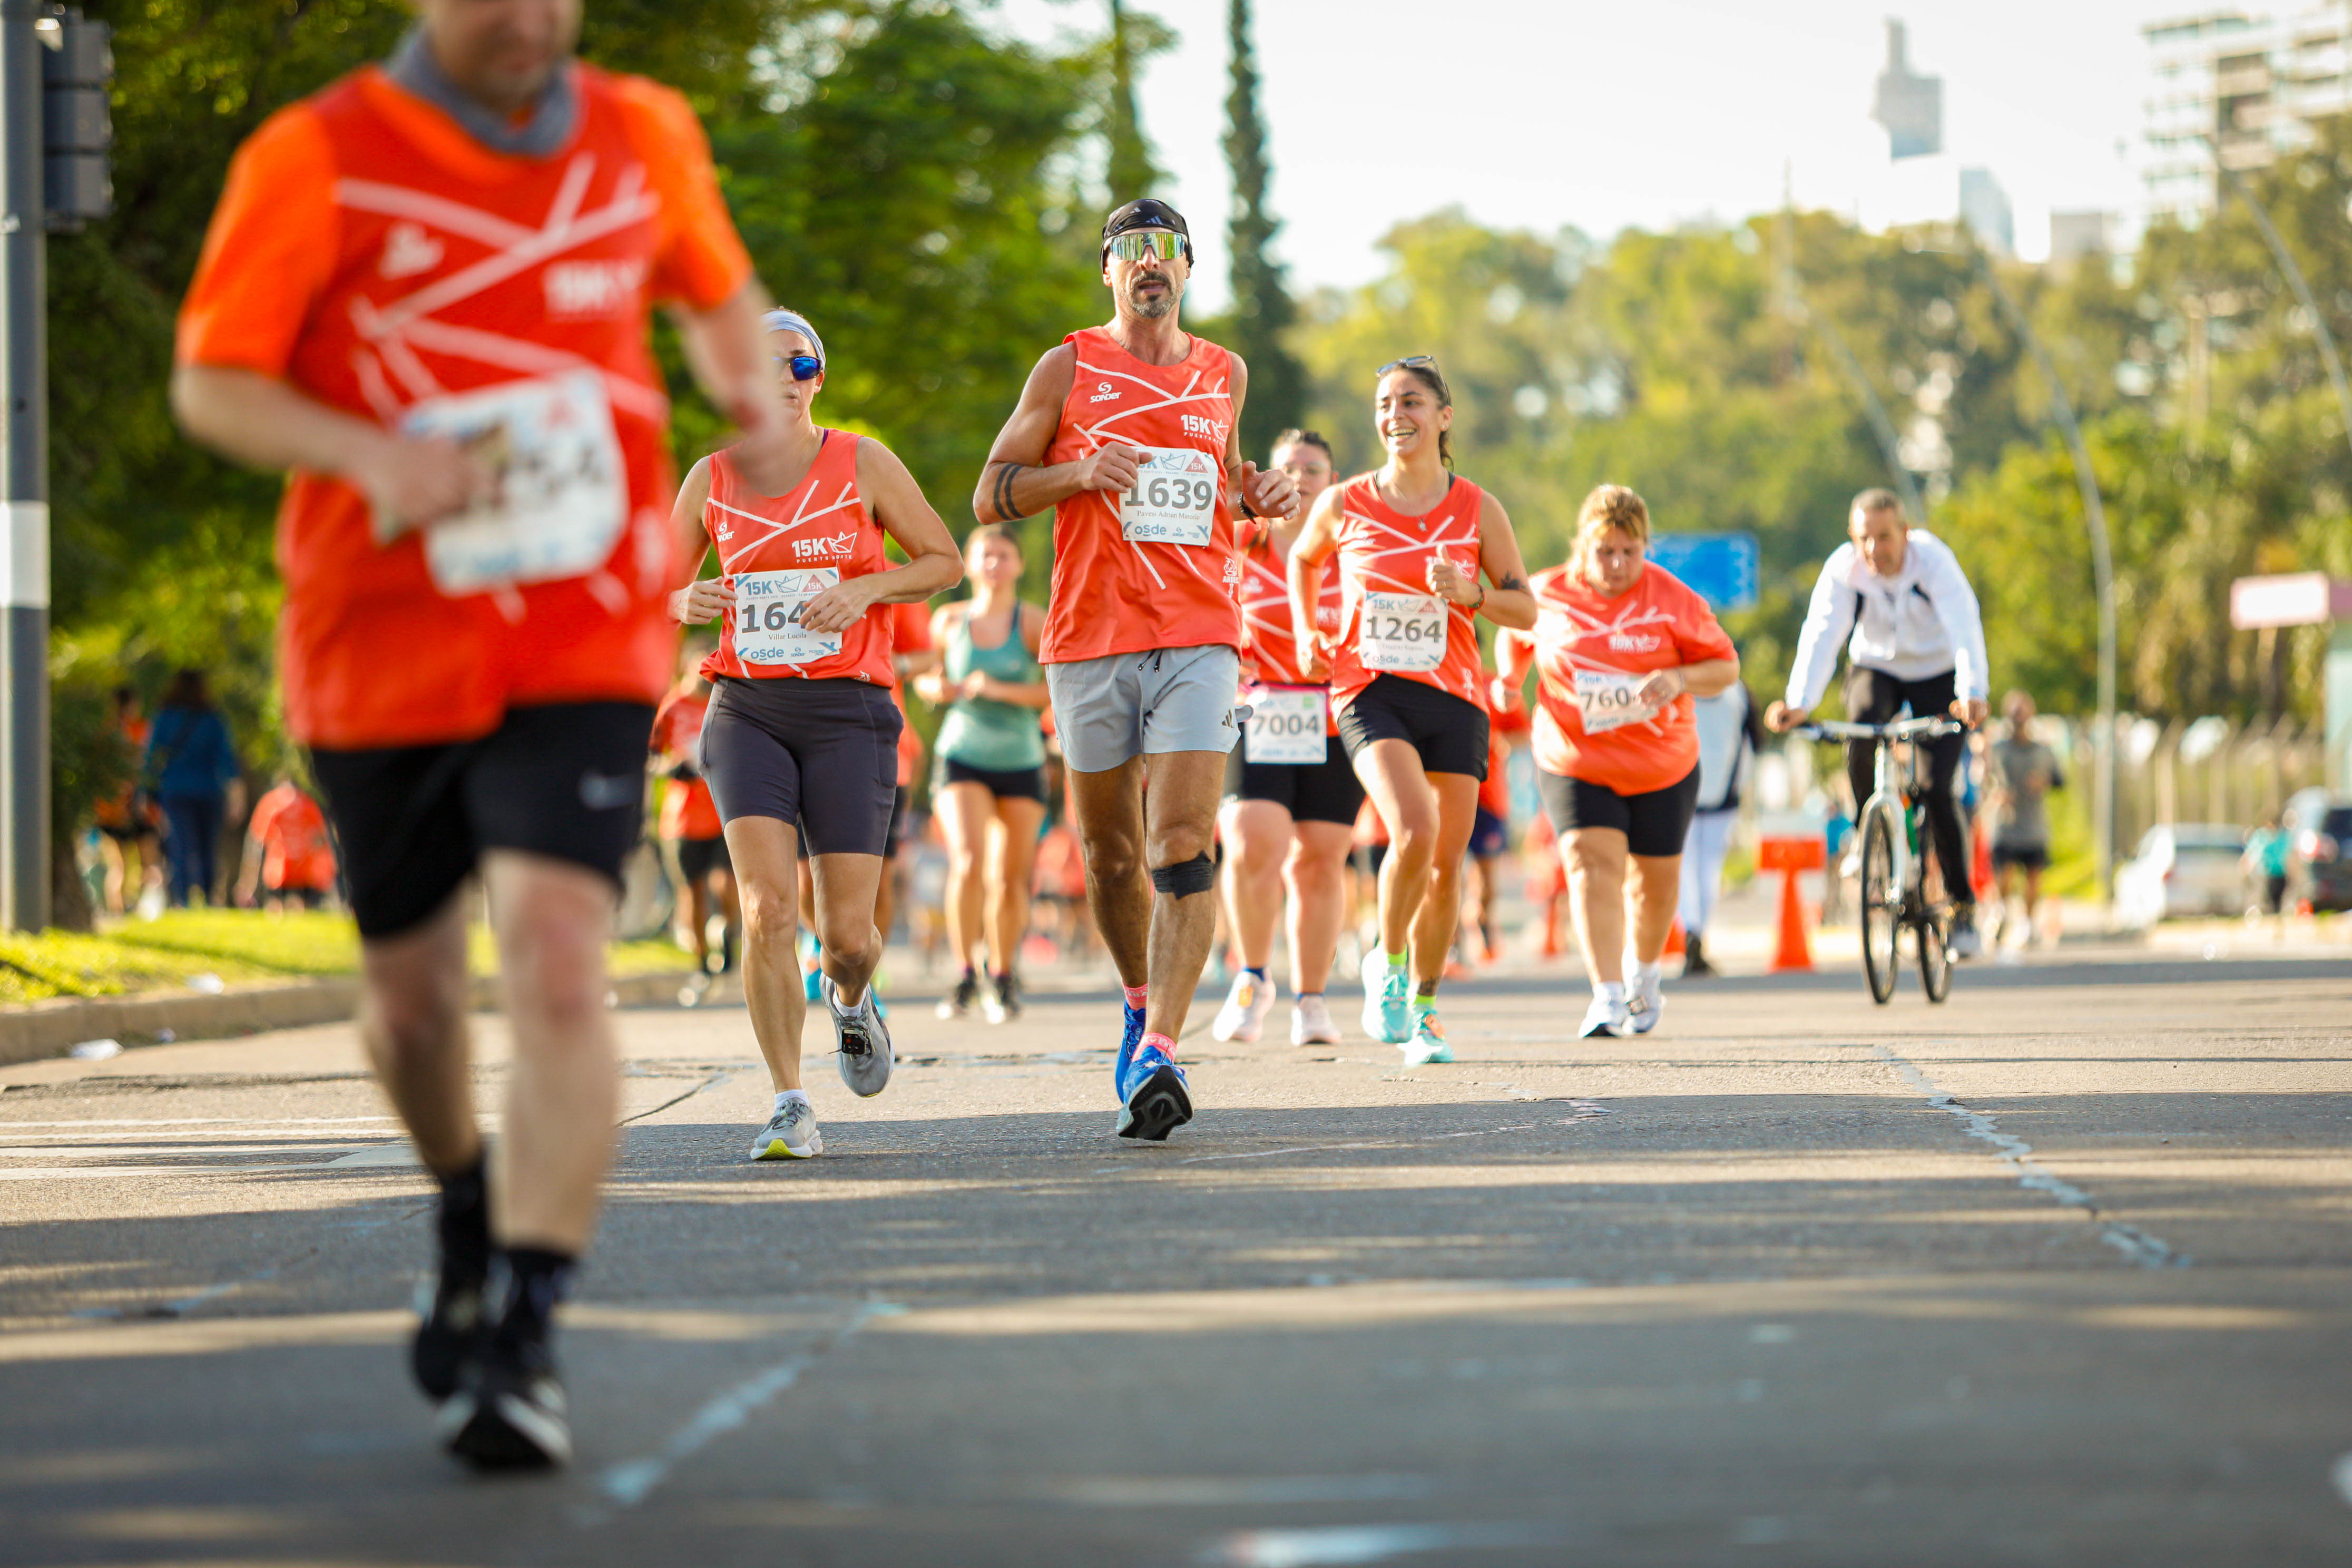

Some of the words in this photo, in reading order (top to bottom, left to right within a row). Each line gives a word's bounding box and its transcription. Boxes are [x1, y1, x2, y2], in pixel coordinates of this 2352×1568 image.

[1181, 414, 1211, 435] 15K
[1125, 476, 1212, 511] 1639
[1134, 524, 1167, 536] osde
[791, 537, 828, 557] 15K
[746, 581, 773, 595] 15K
[1373, 599, 1395, 610] 15K
[742, 601, 808, 633] 164
[1366, 616, 1443, 643] 1264
[751, 646, 785, 660] osde
[1580, 687, 1635, 711] 760
[1252, 714, 1320, 736] 7004
